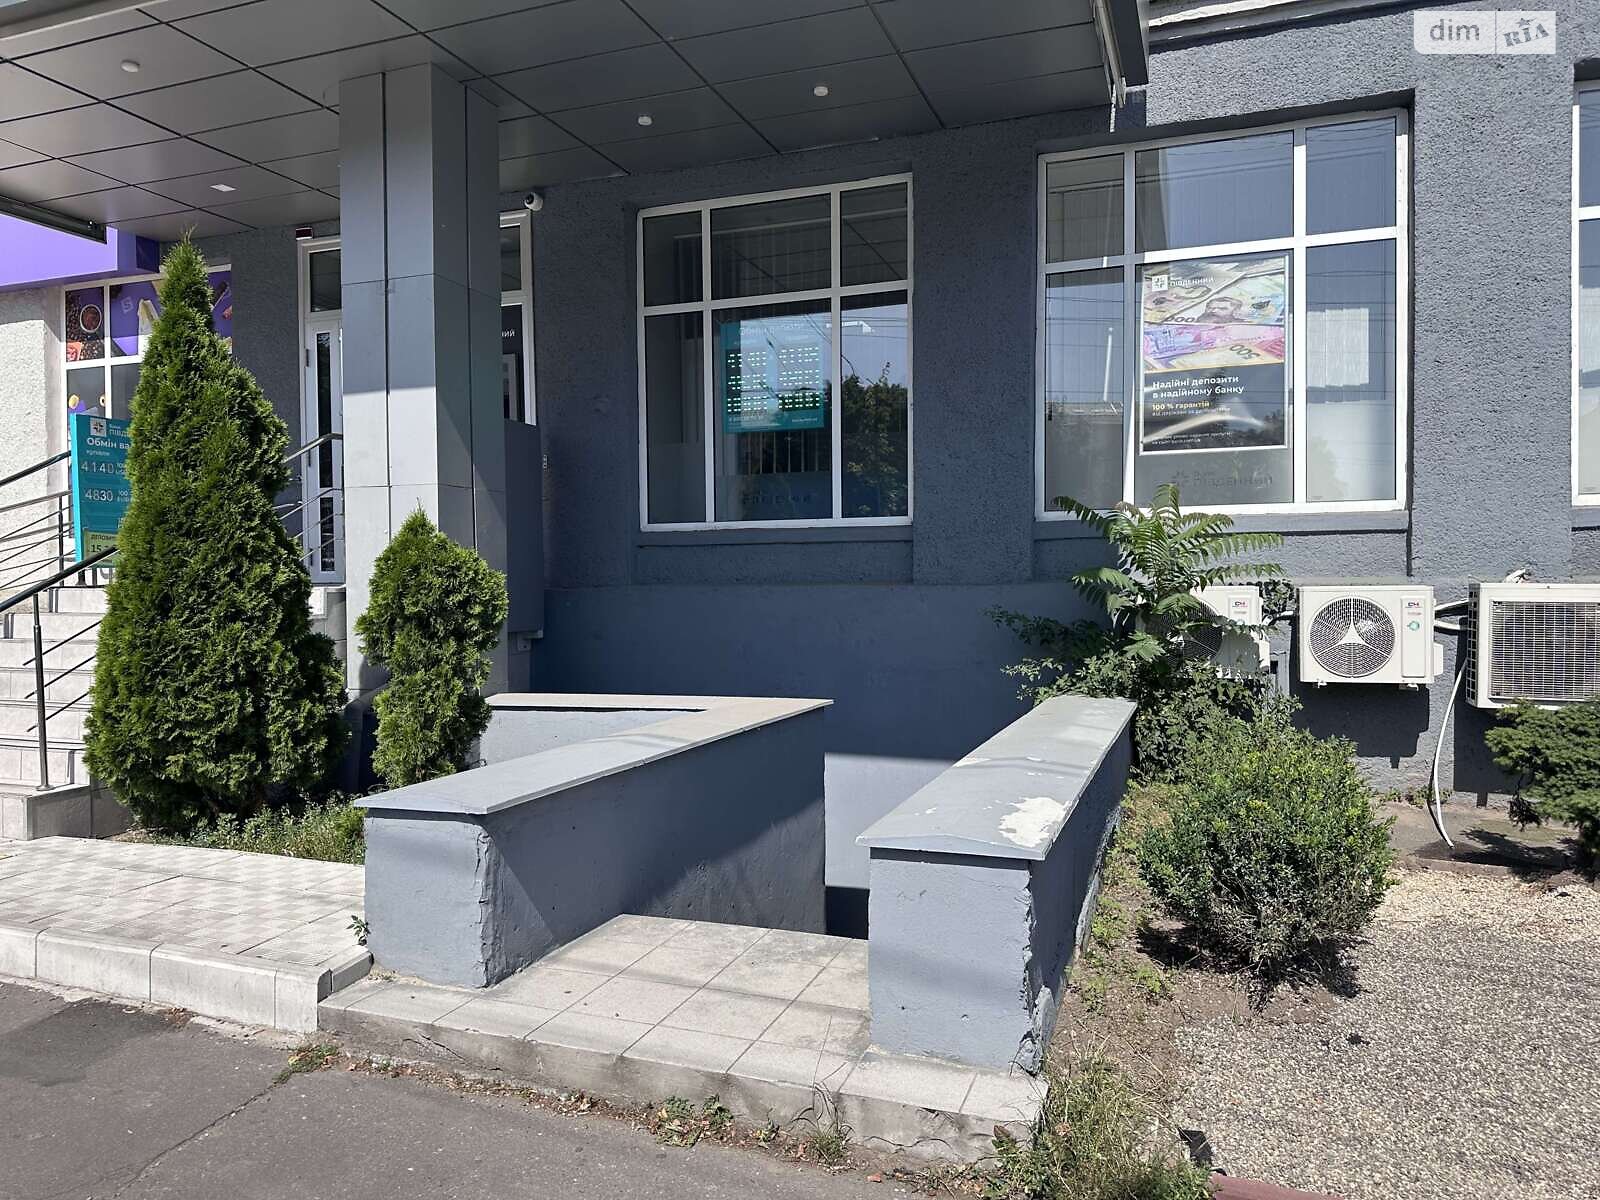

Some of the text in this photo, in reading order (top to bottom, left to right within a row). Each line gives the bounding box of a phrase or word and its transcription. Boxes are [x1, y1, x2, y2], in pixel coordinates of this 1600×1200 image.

[1152, 376, 1239, 390] Надійні депозити
[1160, 387, 1212, 398] надійному
[1215, 385, 1244, 394] банку
[1176, 400, 1210, 409] гарантій
[86, 437, 117, 449] Обмін
[85, 488, 113, 502] 4830
